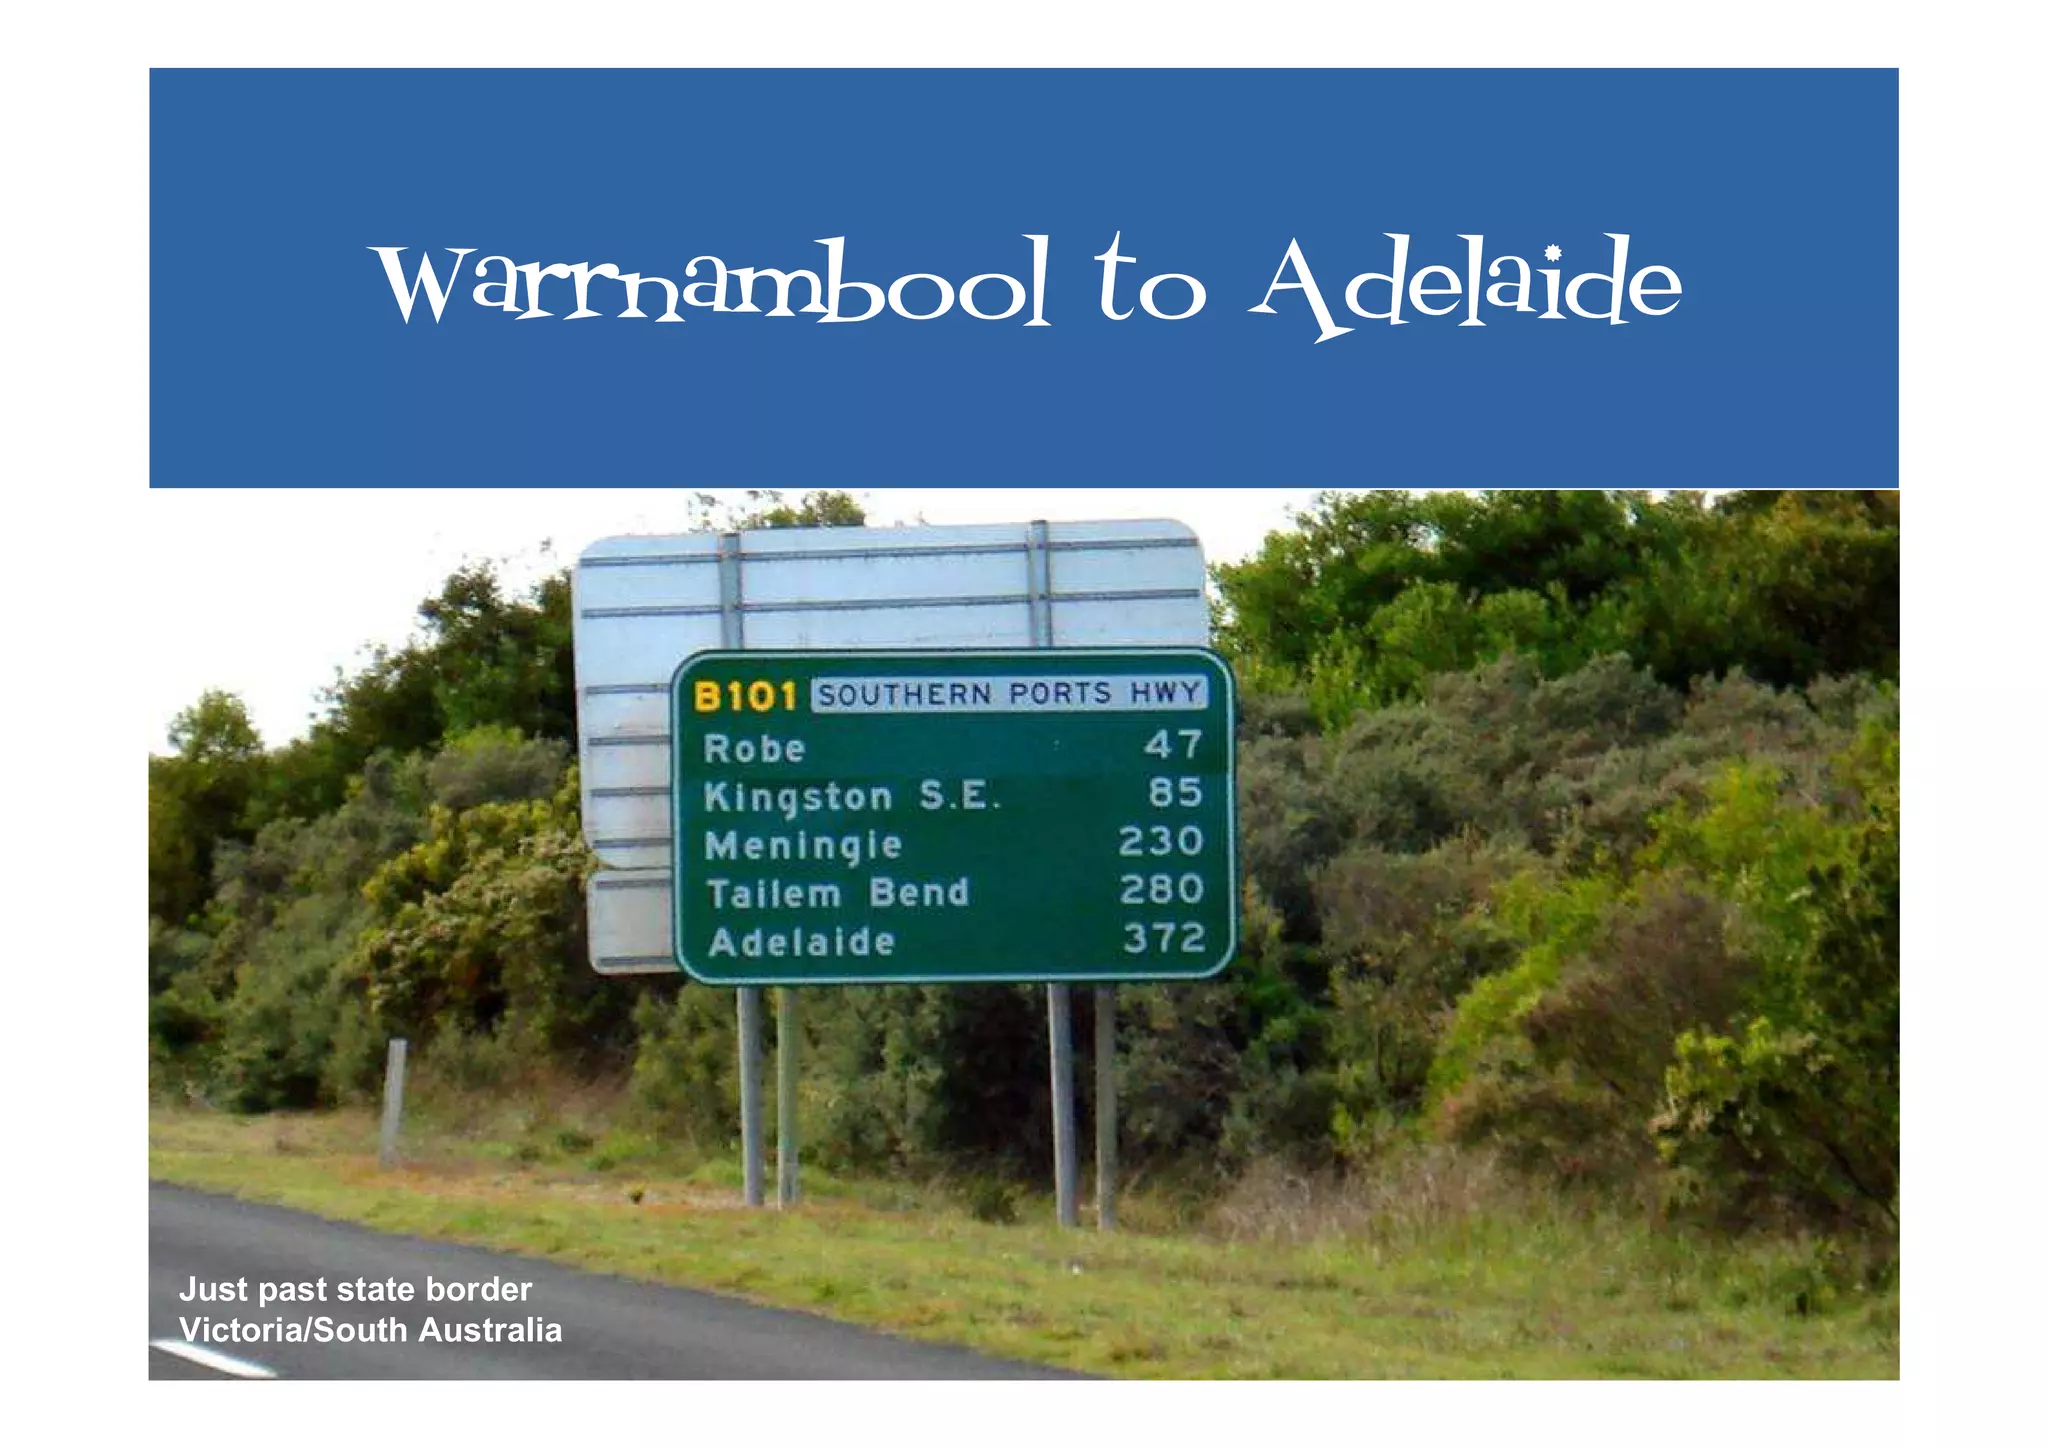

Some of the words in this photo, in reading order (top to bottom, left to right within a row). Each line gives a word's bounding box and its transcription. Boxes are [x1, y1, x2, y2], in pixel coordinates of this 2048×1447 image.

[695, 681, 796, 712] B101
[818, 683, 992, 707] SOUTHERN
[1010, 681, 1111, 705] PORTS
[1131, 680, 1201, 703] HWY
[704, 733, 806, 764] Robe
[1144, 730, 1202, 759] 47
[704, 781, 892, 820] Kingston
[920, 780, 1001, 810] S.E.
[1149, 778, 1203, 807] 85
[705, 830, 902, 867] Meningie
[1119, 826, 1203, 856] 230
[707, 879, 841, 909] Tailem
[870, 877, 969, 907] Bend
[1120, 875, 1204, 905] 280
[708, 927, 895, 958] Adelaide
[1124, 924, 1206, 953] 372
